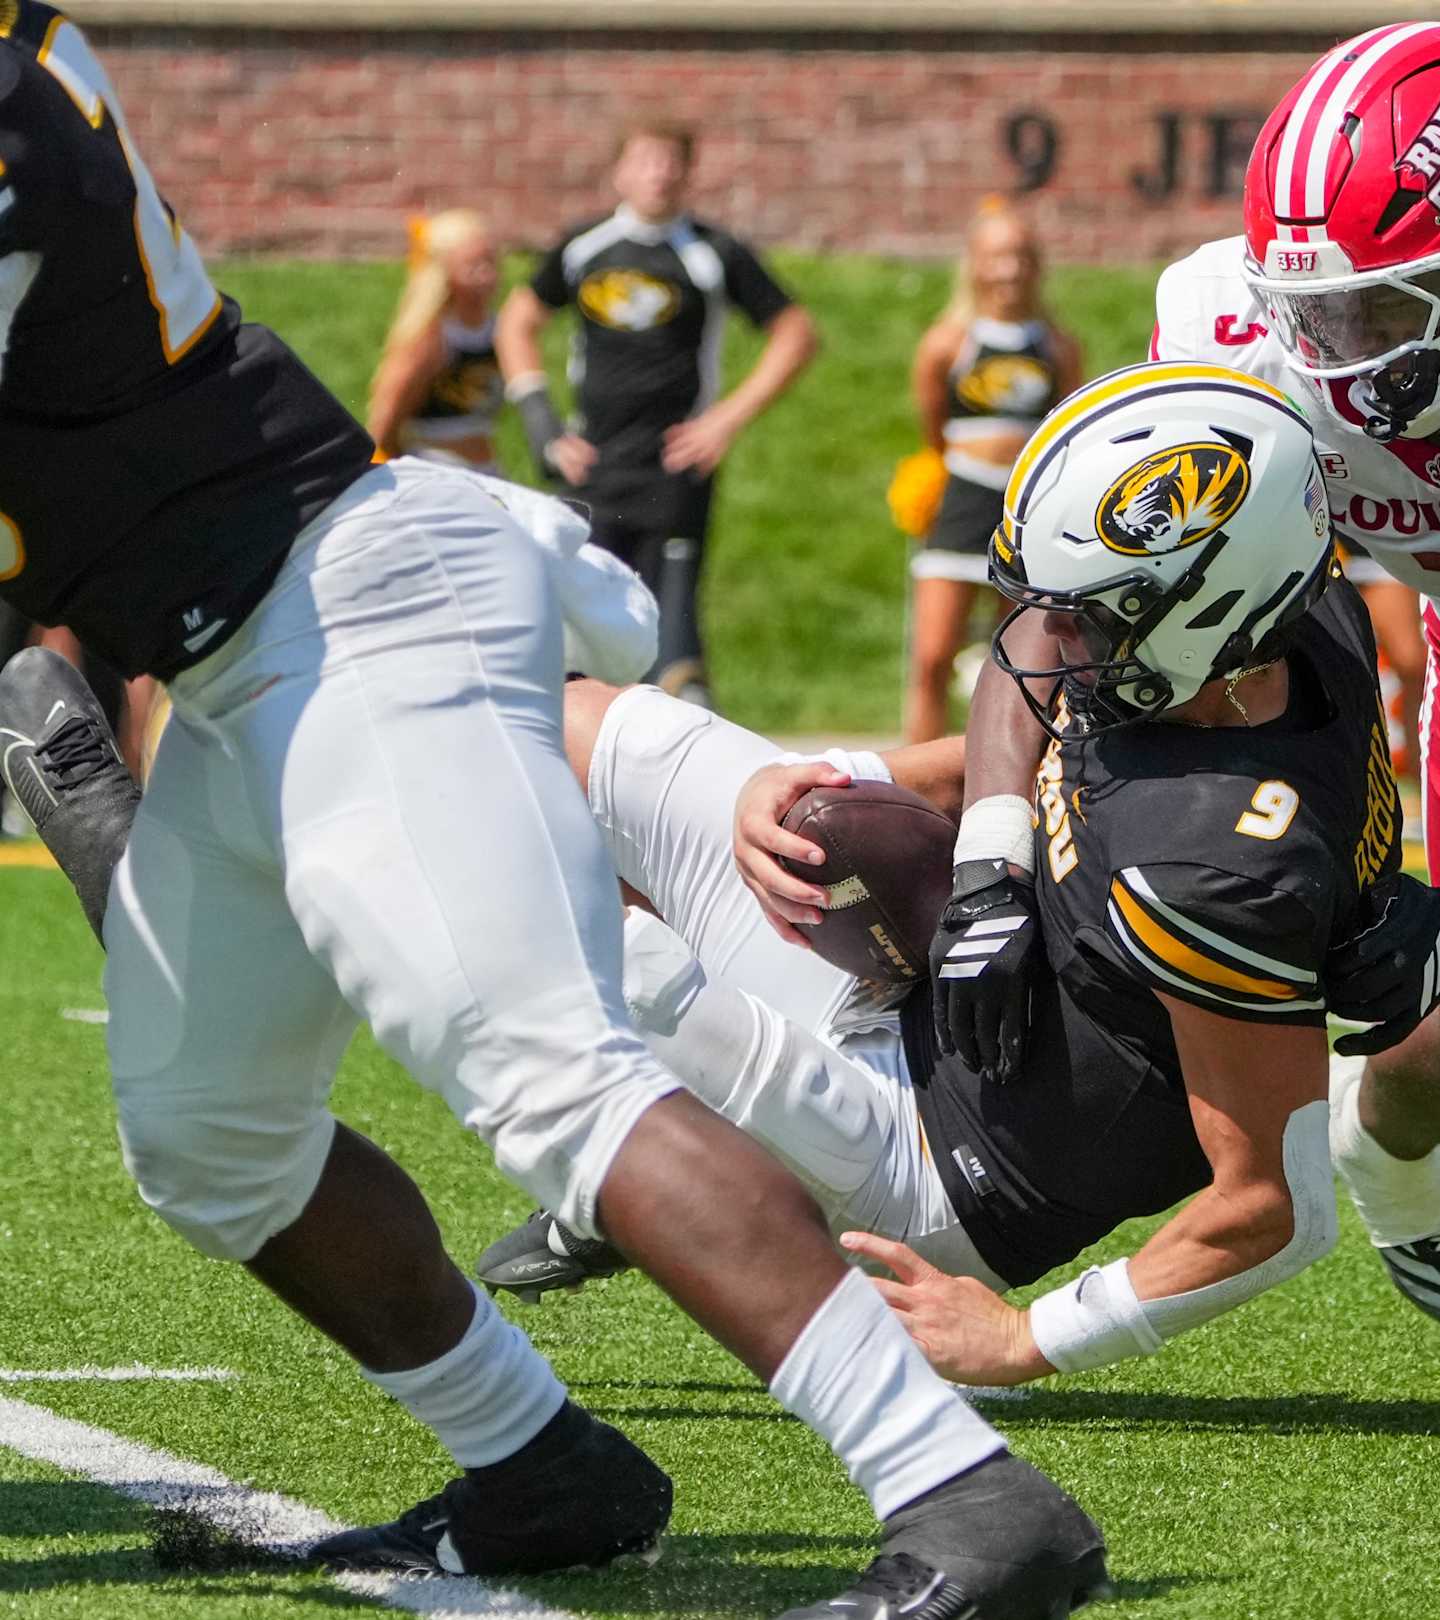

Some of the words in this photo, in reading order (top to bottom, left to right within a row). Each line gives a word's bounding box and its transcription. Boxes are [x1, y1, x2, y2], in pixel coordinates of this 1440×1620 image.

[1003, 107, 1062, 196] 9
[1277, 252, 1317, 271] 337
[1234, 778, 1300, 841] 9
